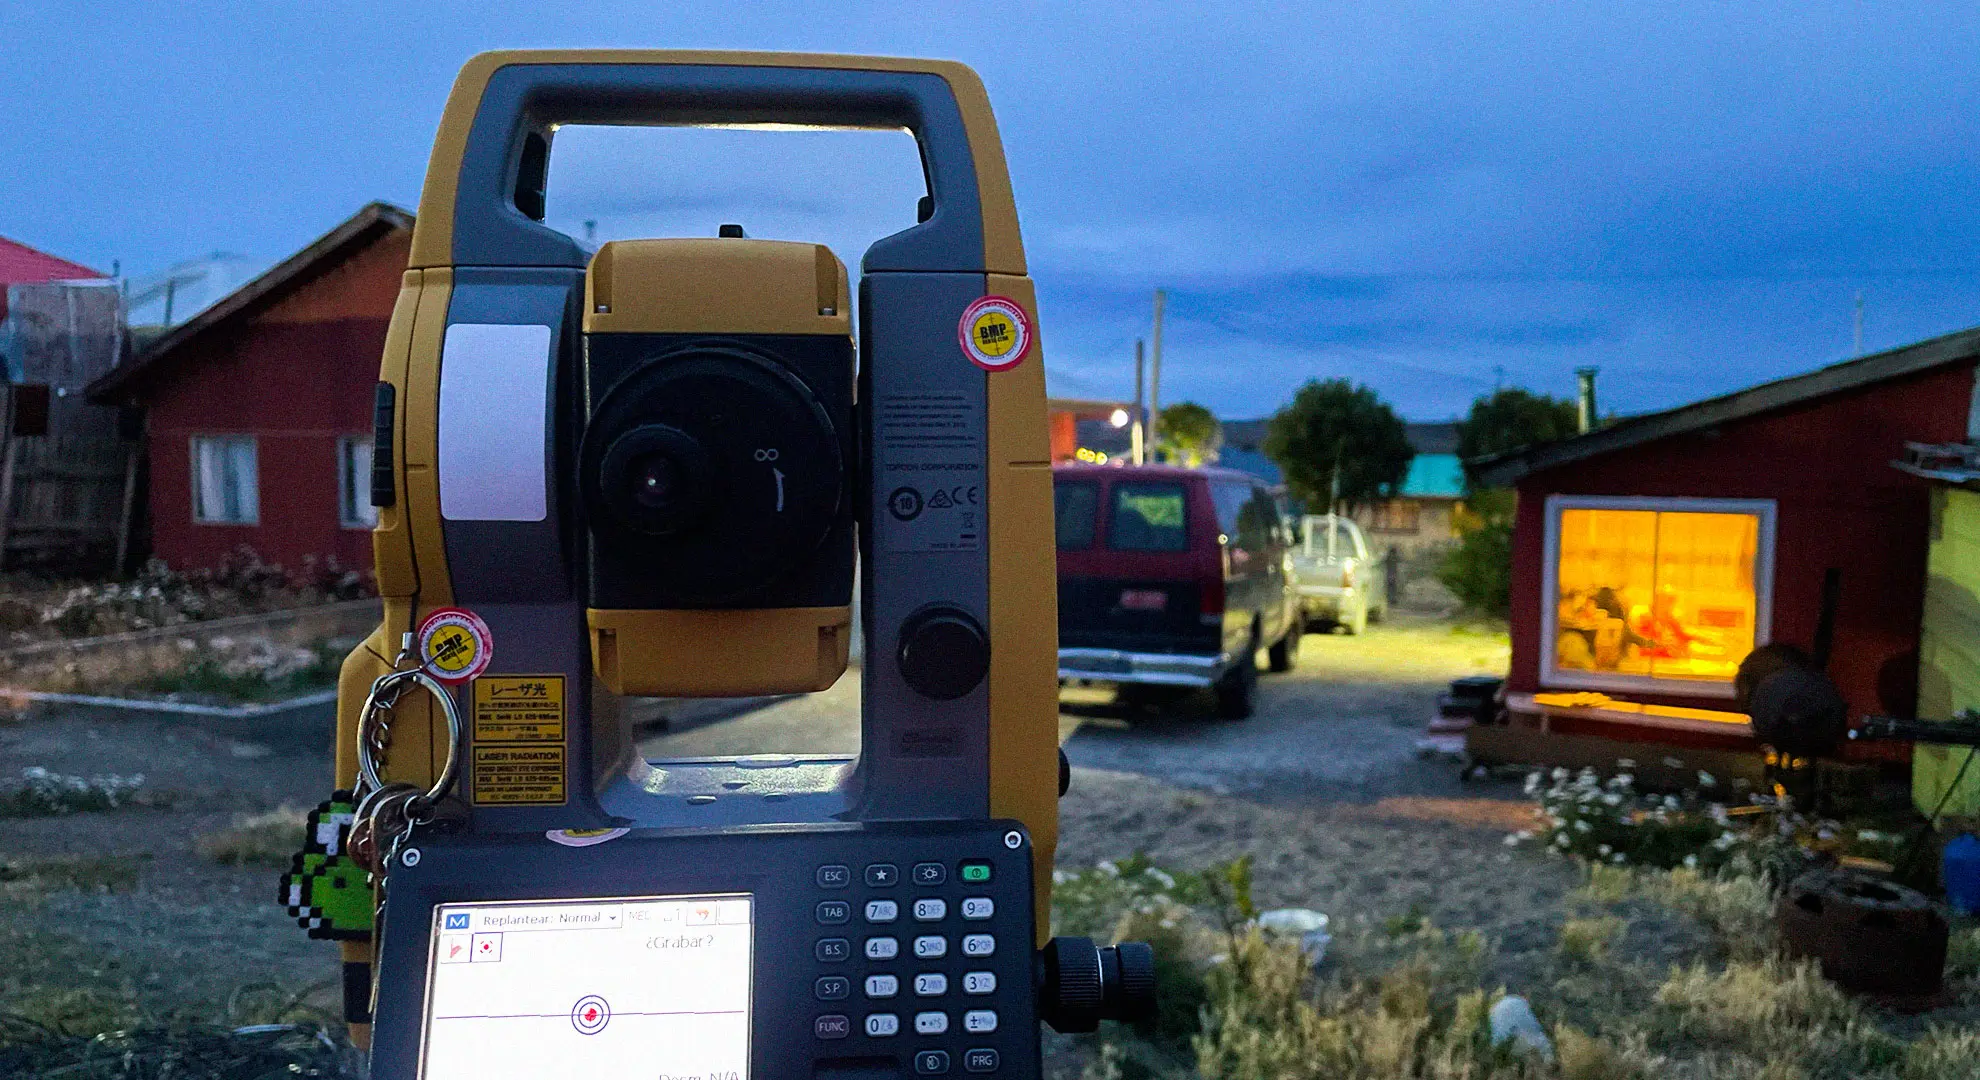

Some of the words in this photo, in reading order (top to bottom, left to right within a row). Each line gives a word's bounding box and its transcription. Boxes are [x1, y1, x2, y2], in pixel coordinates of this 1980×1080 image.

[980, 323, 1006, 339] BMP
[920, 463, 979, 471] CORPORATION
[491, 683, 547, 696] レーザ光
[477, 752, 508, 760] LASER
[511, 751, 560, 760] RADIATION
[824, 871, 842, 881] ESC
[824, 907, 843, 917] TAB
[870, 904, 879, 918] 7
[918, 903, 927, 916] 8
[967, 902, 976, 915] 9
[483, 914, 553, 929] Replantear:
[559, 911, 601, 924] Normal
[646, 933, 714, 951] ¿Grabar?
[919, 940, 927, 953] 5
[968, 939, 977, 952] 6
[870, 943, 879, 955] 4
[872, 980, 878, 993] 1
[919, 978, 927, 991] 2
[969, 976, 977, 990] 3
[819, 1022, 845, 1032] FUNC
[870, 1018, 879, 1032] 0
[972, 1056, 993, 1066] PRG
